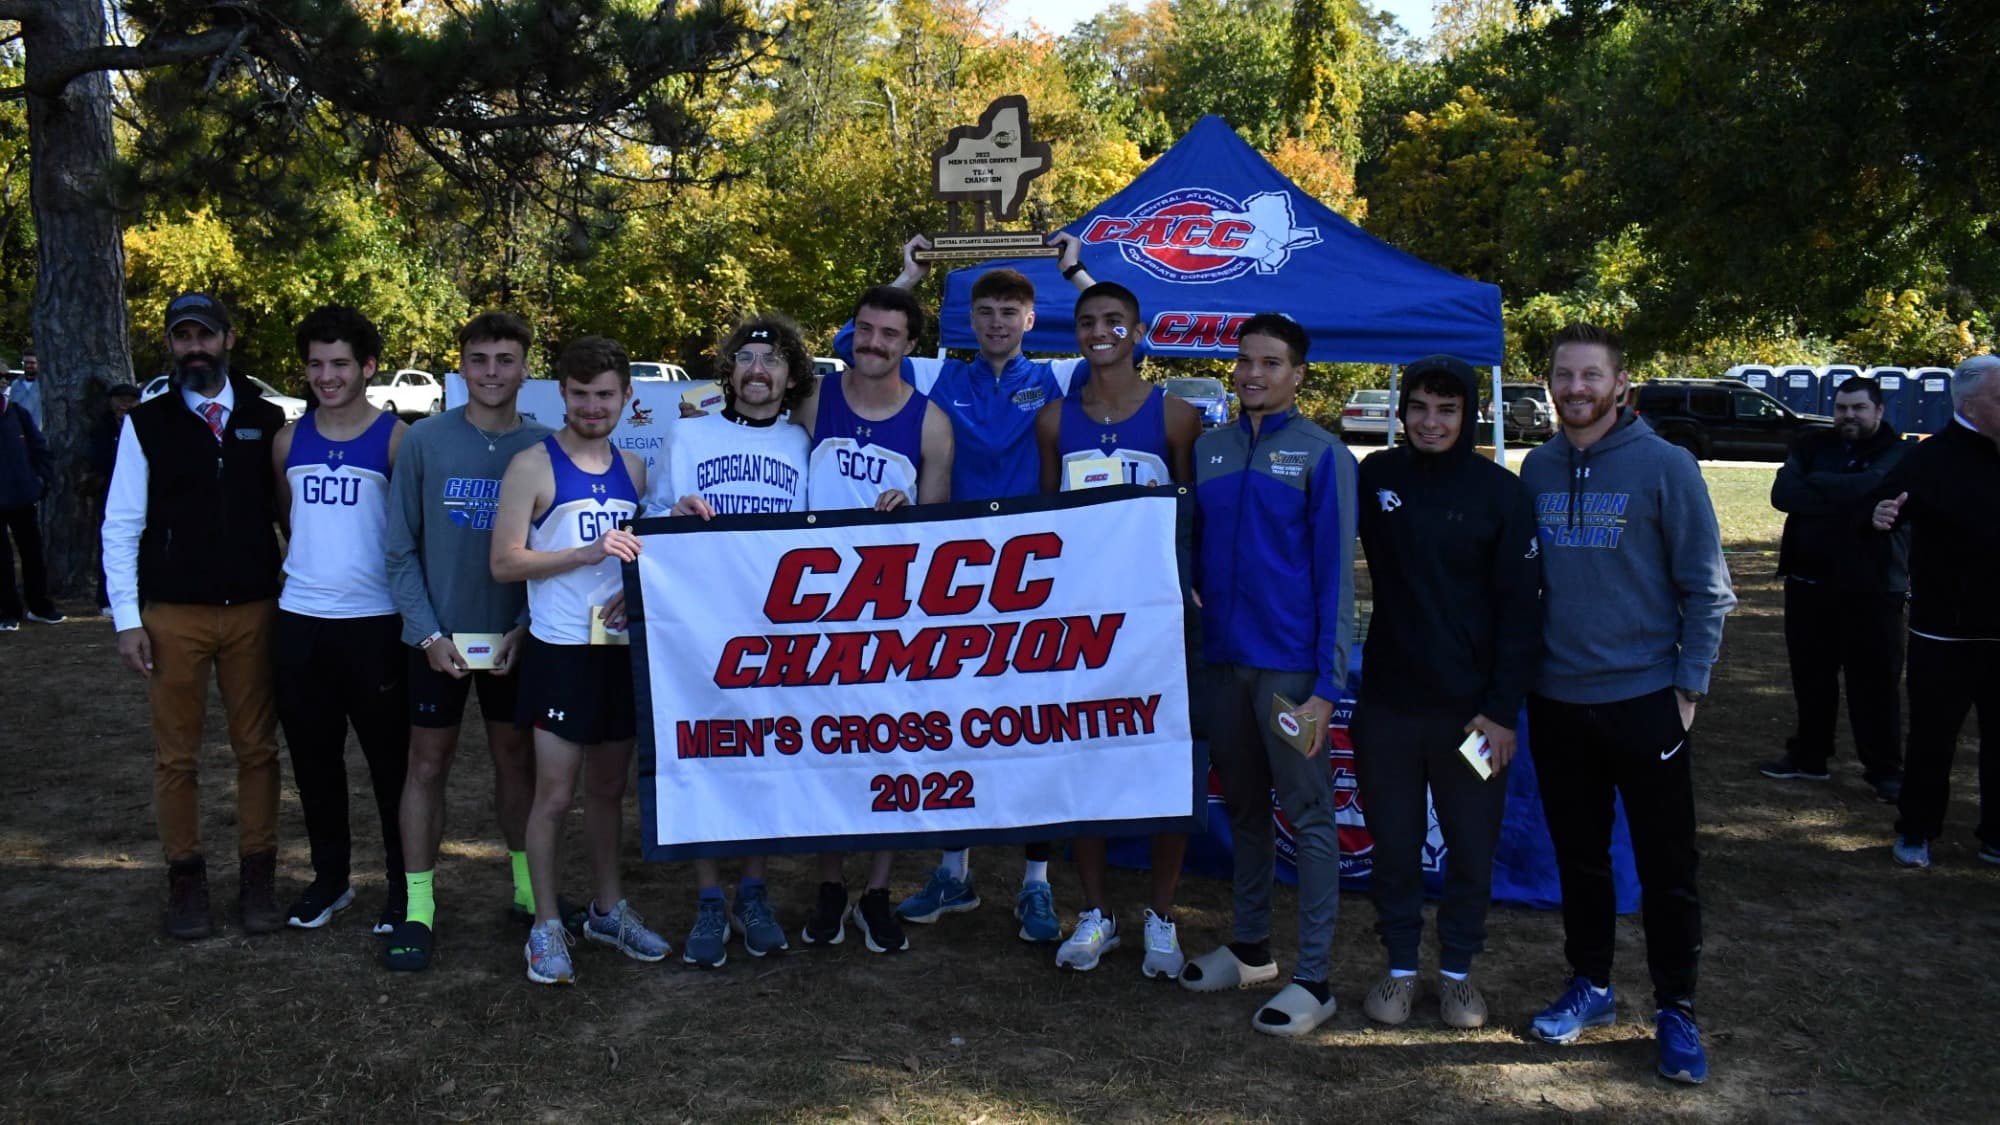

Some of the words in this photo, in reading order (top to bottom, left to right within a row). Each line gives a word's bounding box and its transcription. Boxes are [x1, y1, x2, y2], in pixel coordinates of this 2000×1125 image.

[1138, 195, 1182, 216] CENTRAL
[1186, 192, 1235, 211] ATLANTIC
[1083, 217, 1254, 250] CACC
[1180, 261, 1248, 280] CONFERENCE
[1149, 312, 1246, 346] CAC
[697, 454, 762, 491] GEORGIAN
[763, 459, 799, 497] COURT
[836, 448, 887, 484] GCU
[303, 475, 361, 506] GCU
[443, 478, 502, 498] GEOR
[704, 494, 793, 514] UNIVERSITY
[1556, 525, 1624, 549] COURT
[763, 531, 1064, 624] CACC
[713, 613, 1126, 689] CHAMPION
[676, 716, 803, 759] MEN'S
[811, 711, 952, 755] CROSS
[961, 694, 1162, 746] COUNTRY
[870, 770, 976, 812] 2022
